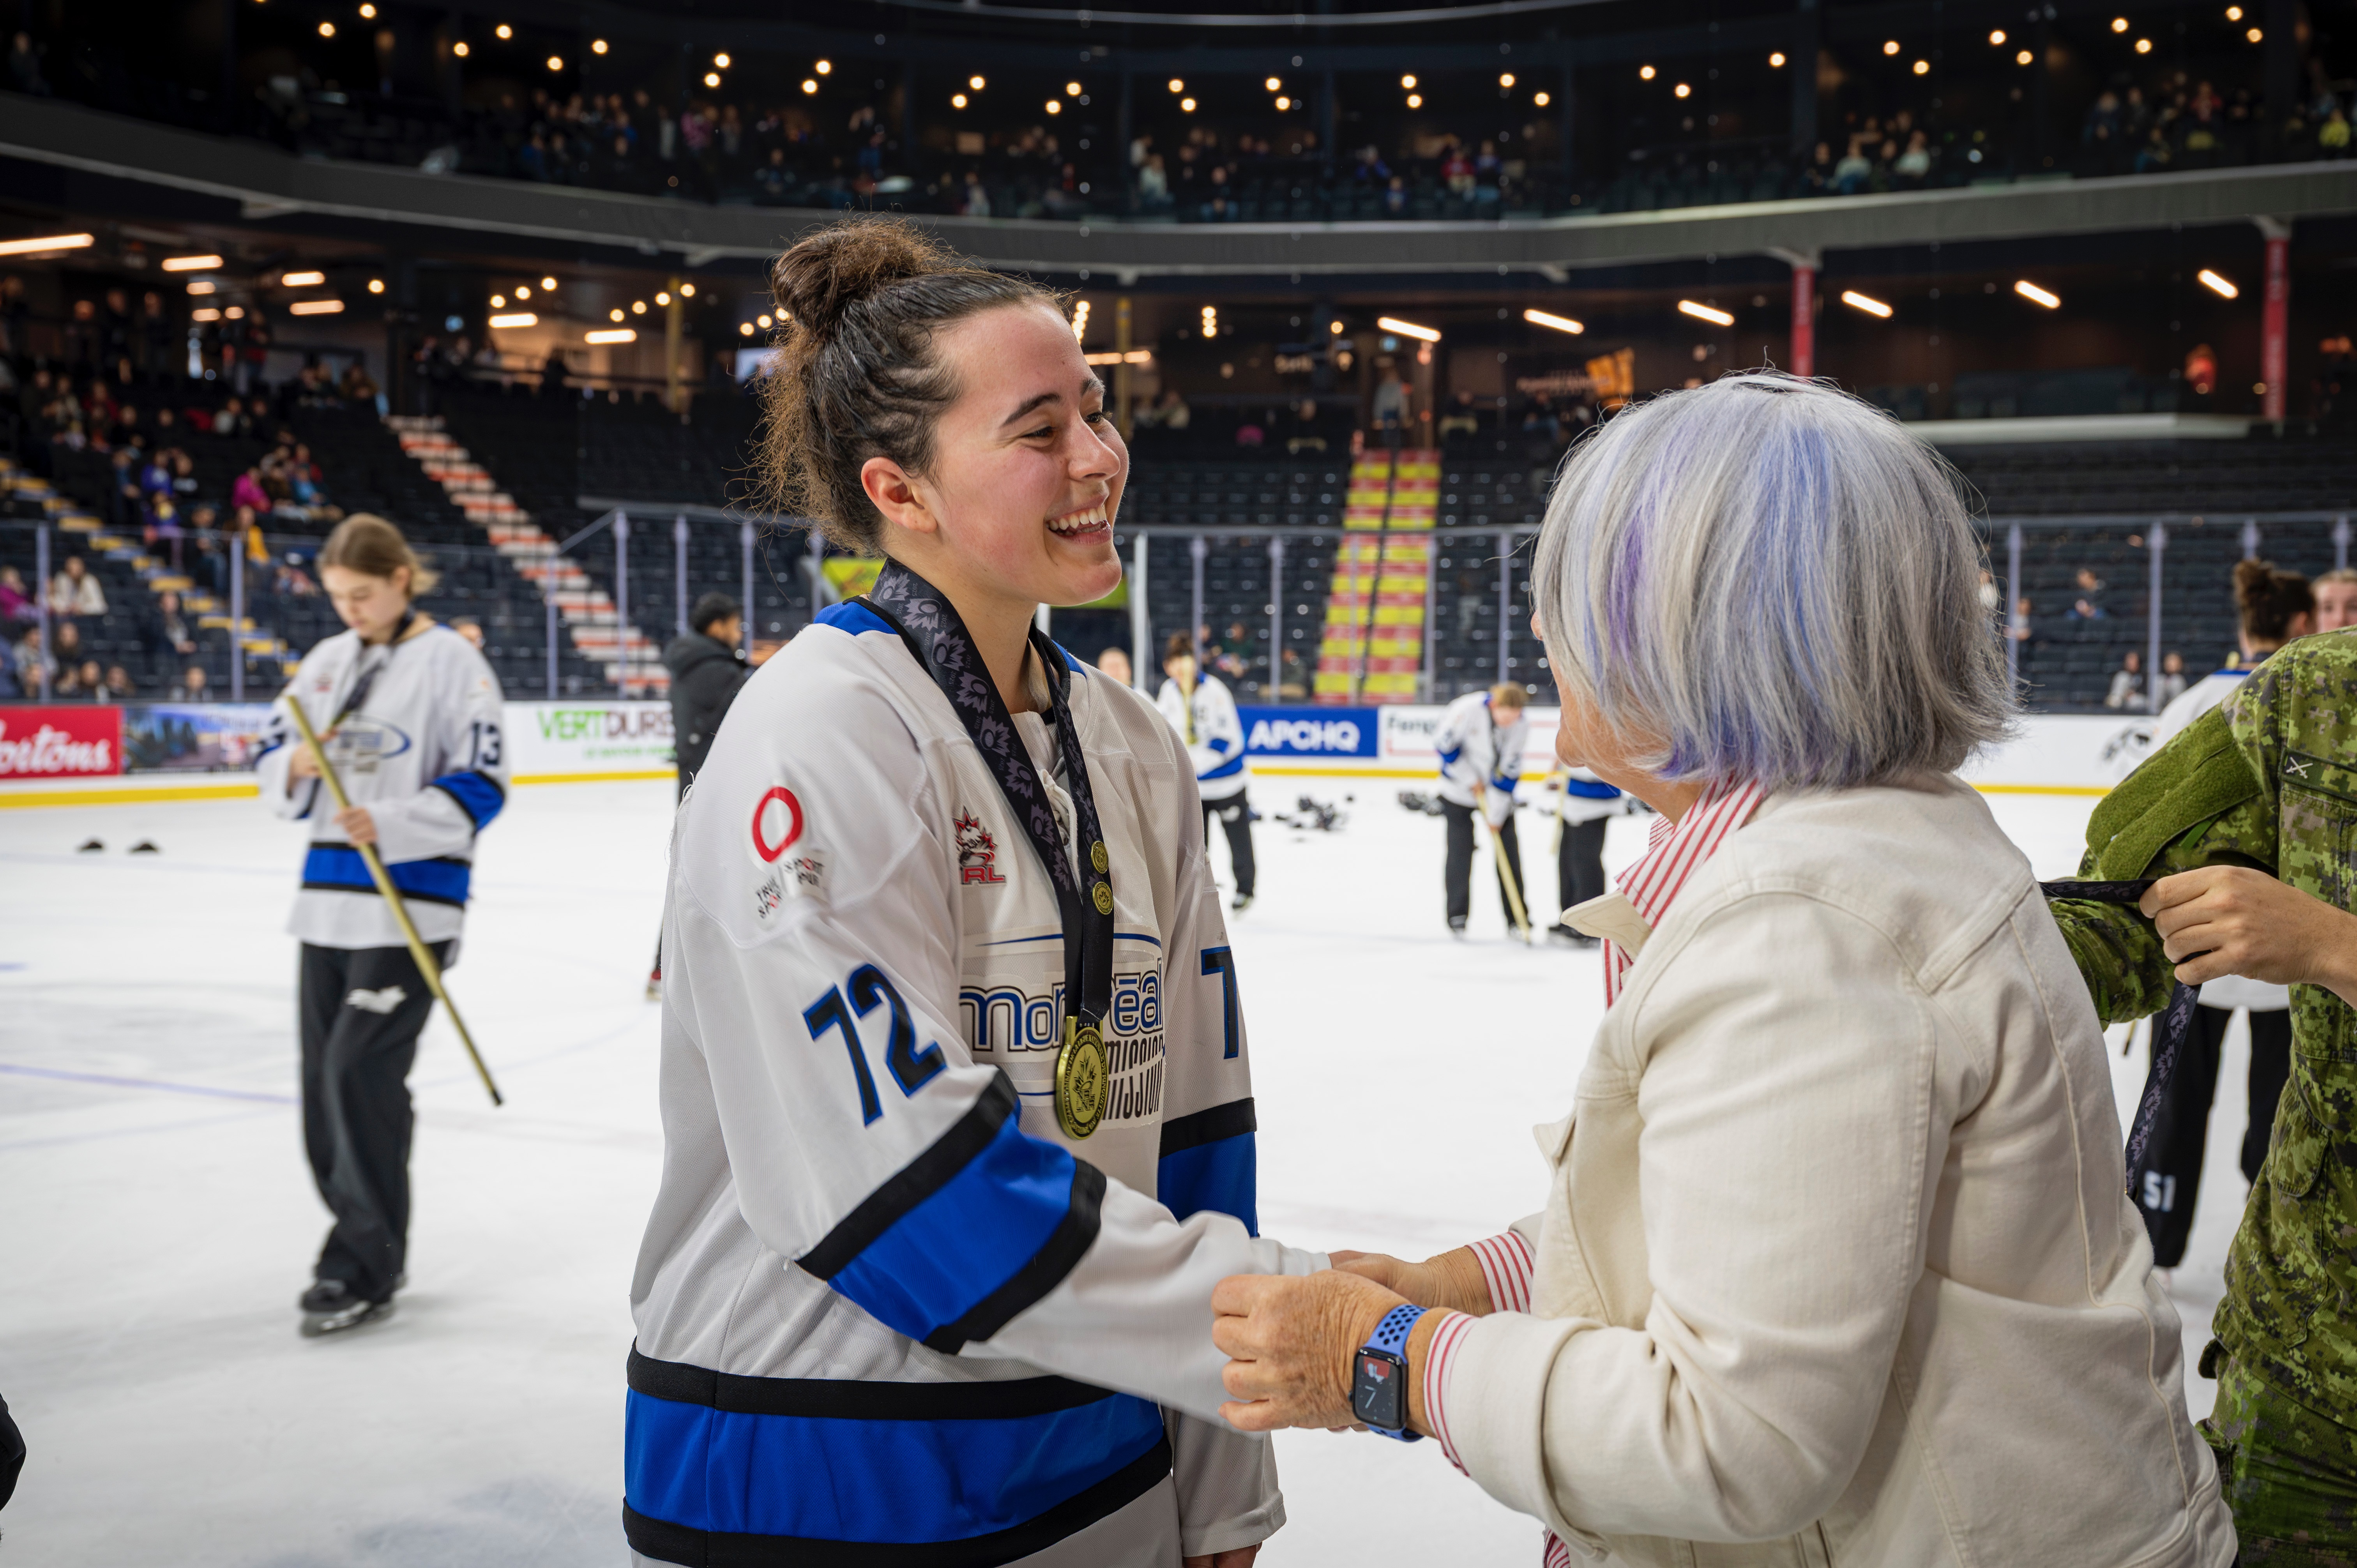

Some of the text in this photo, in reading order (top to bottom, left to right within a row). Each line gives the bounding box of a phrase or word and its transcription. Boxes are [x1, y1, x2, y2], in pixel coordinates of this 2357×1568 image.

[0, 719, 111, 774] ortons
[471, 721, 501, 768] 13
[1248, 720, 1360, 752] APCHQ
[801, 962, 948, 1128] 72
